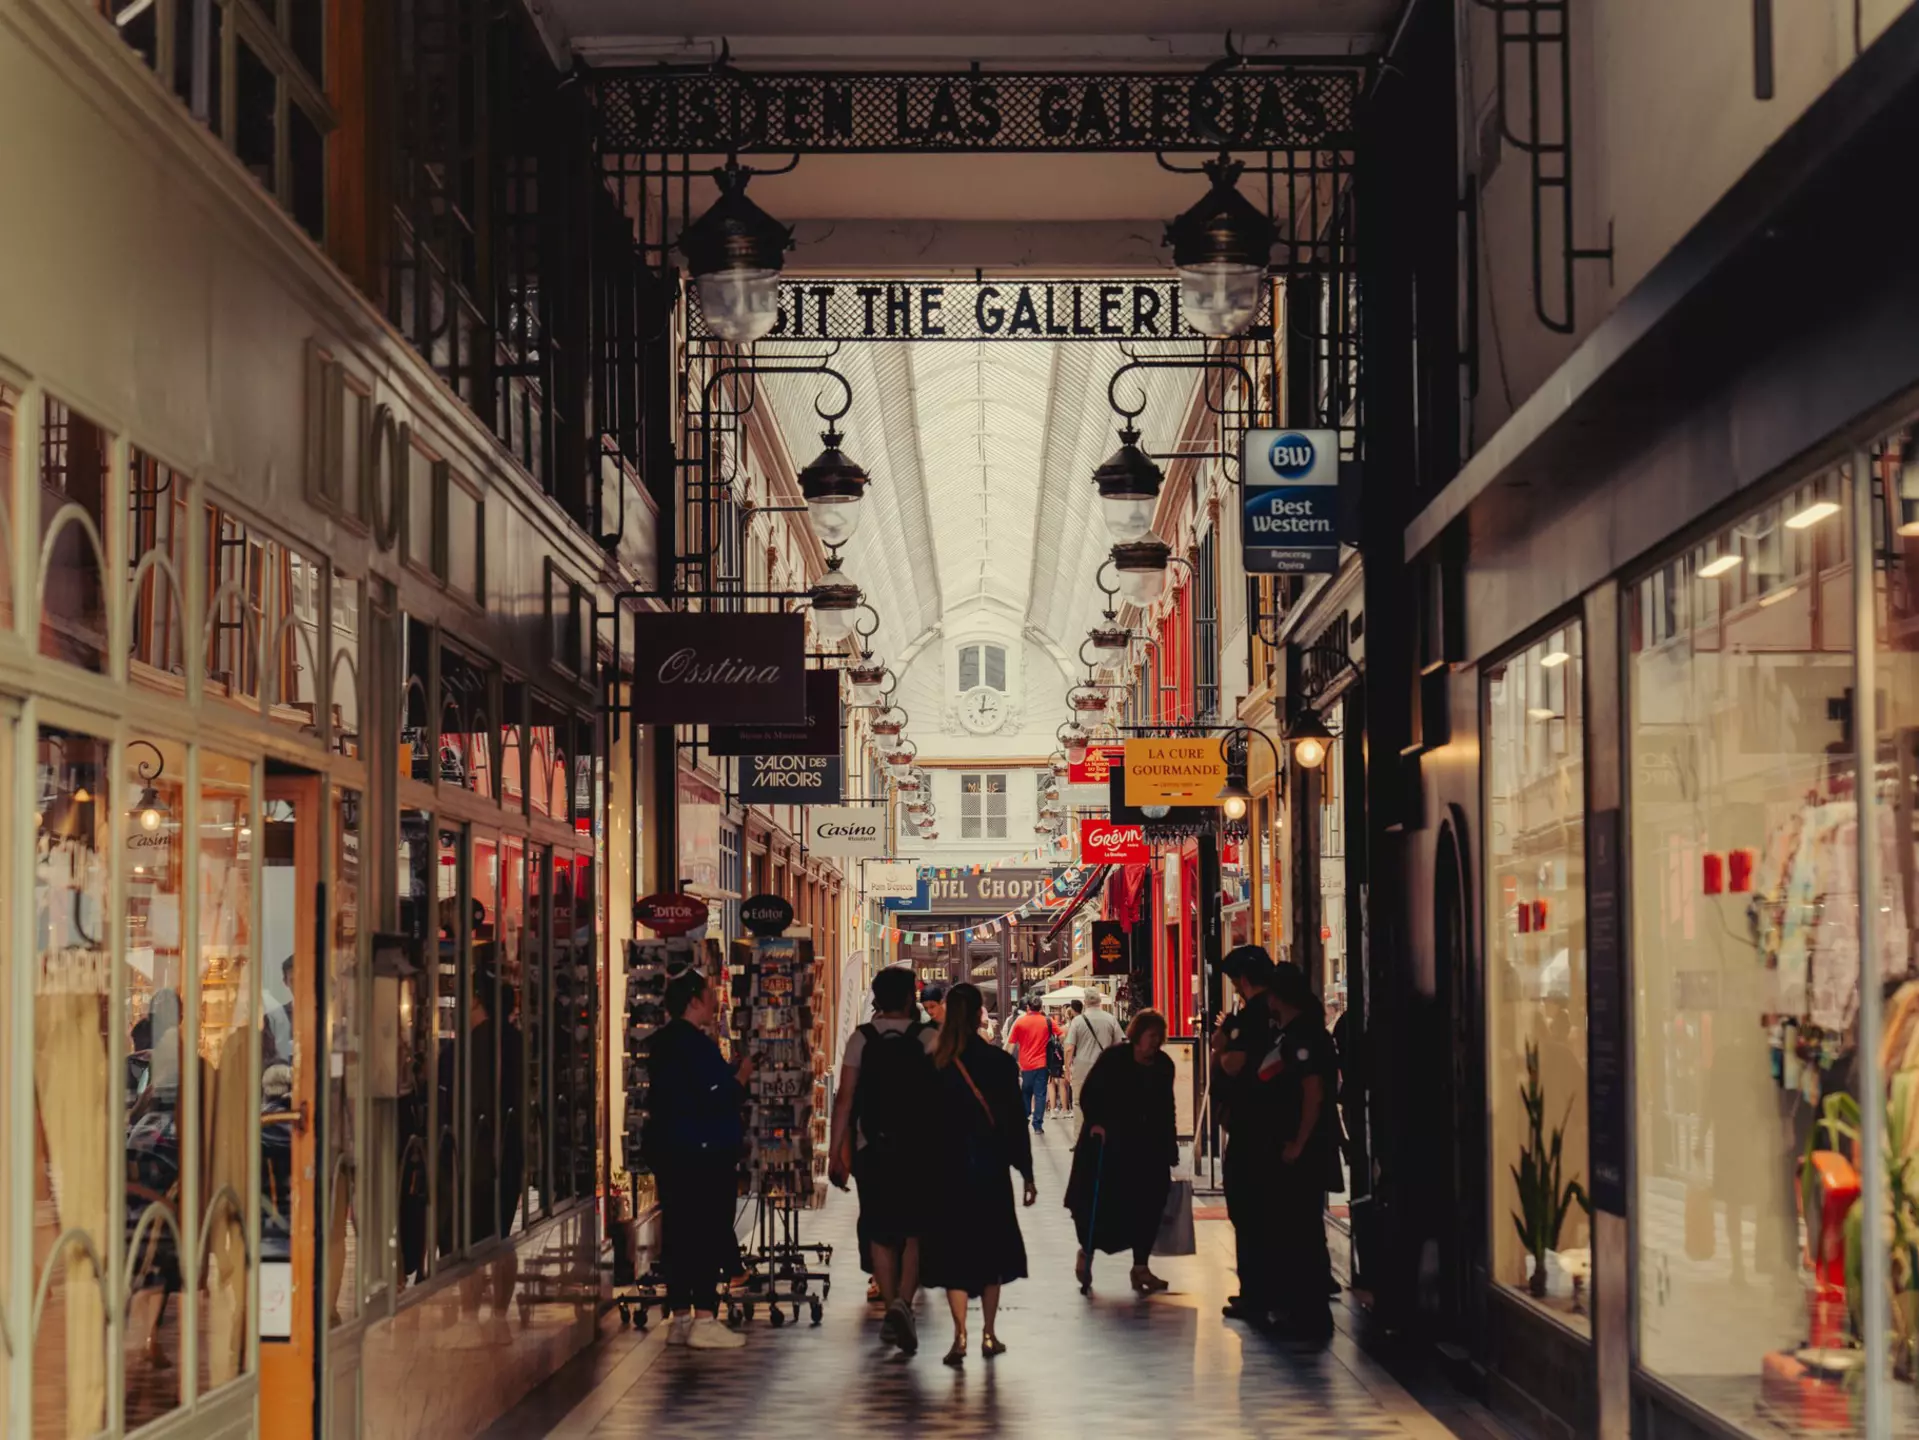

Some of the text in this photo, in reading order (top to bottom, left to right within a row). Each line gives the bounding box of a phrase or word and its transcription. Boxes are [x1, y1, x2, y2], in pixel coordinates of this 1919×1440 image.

[896, 85, 1003, 139] LAS
[859, 287, 944, 336] THE
[1273, 446, 1312, 467] BW
[1271, 498, 1313, 515] Best
[1252, 515, 1330, 532] Western
[657, 647, 781, 685] Osstina
[1148, 748, 1205, 759] LA CURE
[753, 755, 827, 771] SALON DES
[1132, 764, 1221, 776] GOURMANDE
[751, 771, 822, 787] MIROIRS
[816, 822, 877, 839] Casino
[751, 909, 784, 920] Editor
